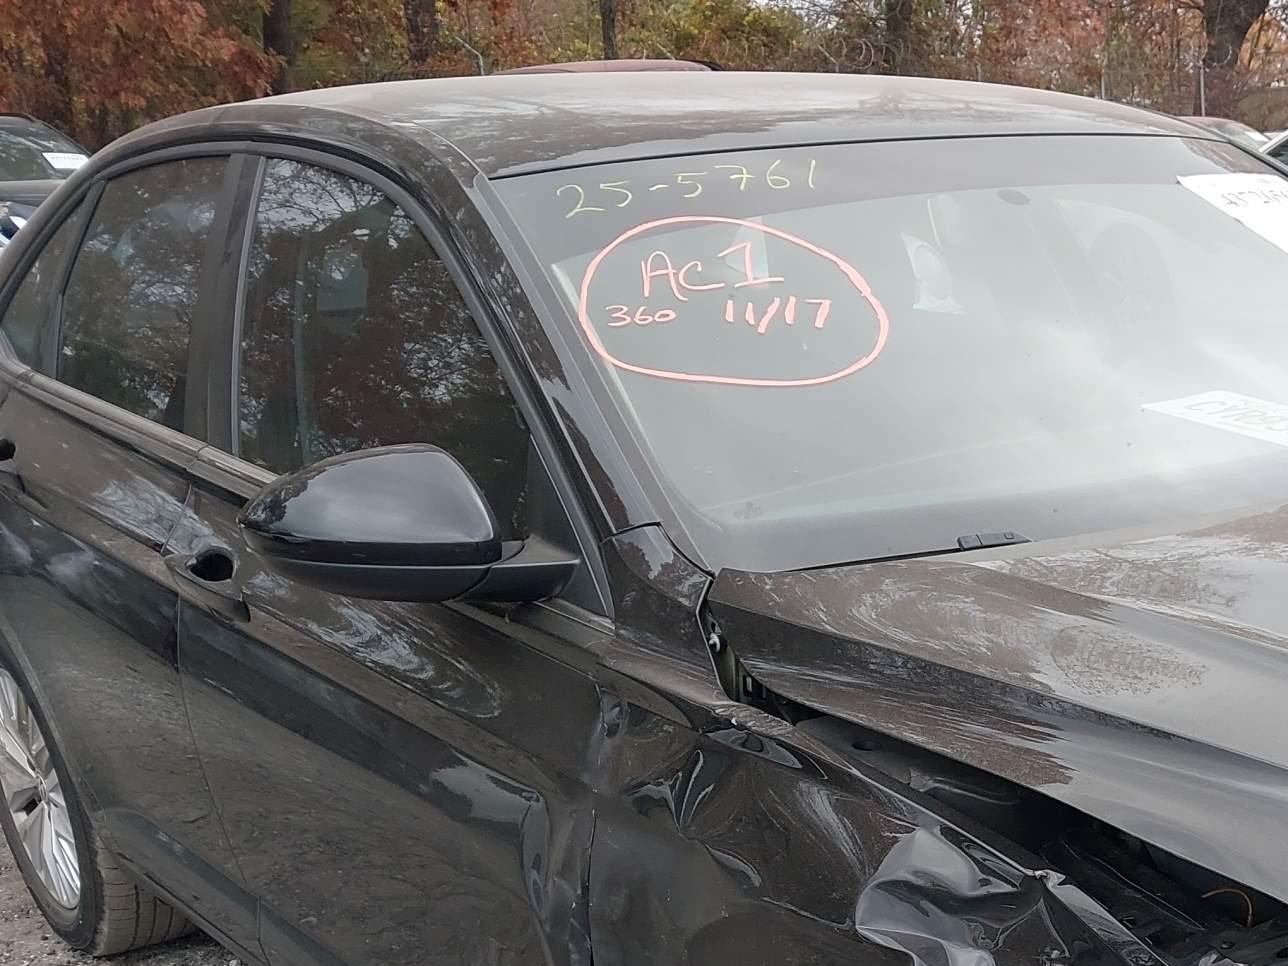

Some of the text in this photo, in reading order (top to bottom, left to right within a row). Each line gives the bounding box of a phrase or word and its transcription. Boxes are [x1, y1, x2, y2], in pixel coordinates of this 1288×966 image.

[557, 158, 817, 217] 25-5761
[605, 295, 832, 334] 360 11/17
